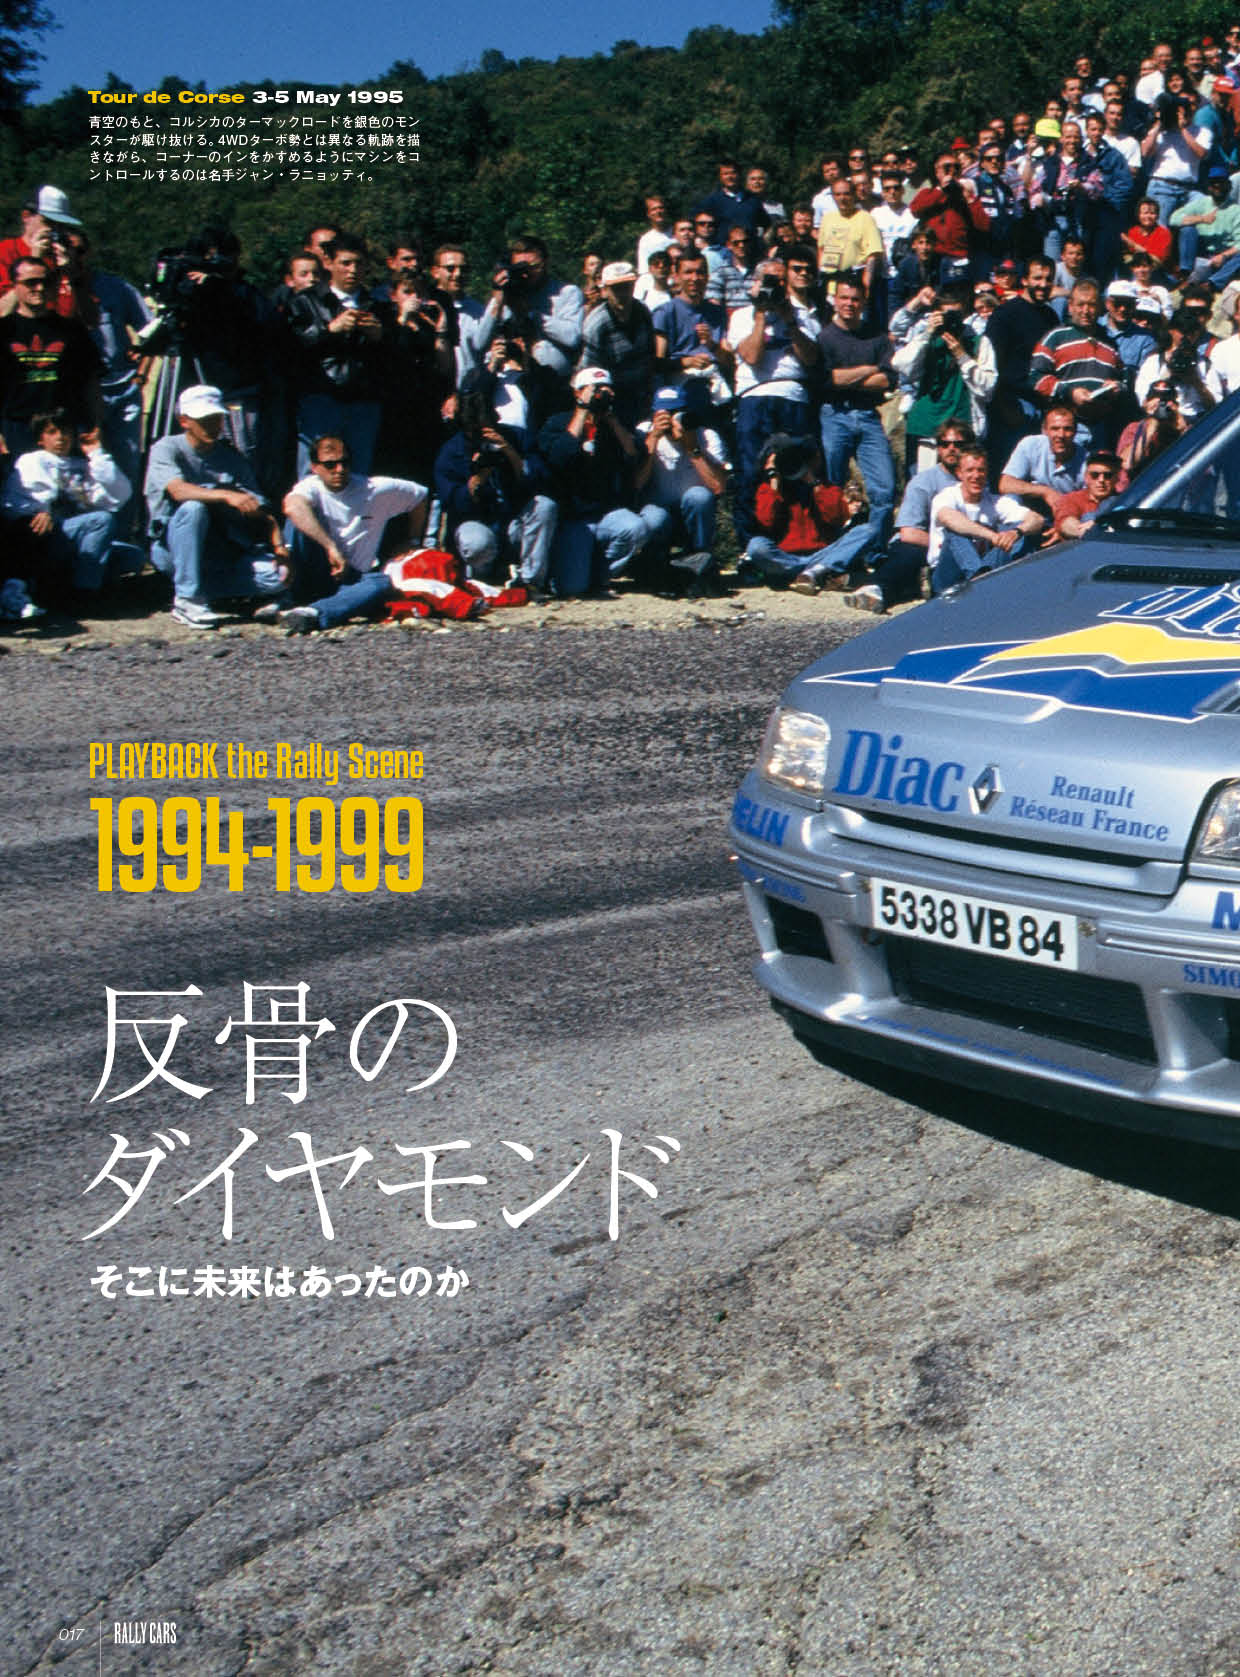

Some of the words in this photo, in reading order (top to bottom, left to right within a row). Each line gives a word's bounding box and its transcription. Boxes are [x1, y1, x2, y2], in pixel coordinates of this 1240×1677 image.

[832, 729, 966, 813] Diac
[1050, 775, 1136, 809] Renault
[1009, 794, 1085, 828] Réseau
[1092, 808, 1170, 842] France
[880, 884, 958, 940] 5338
[962, 902, 1011, 951] VB
[1019, 915, 1065, 962] 84
